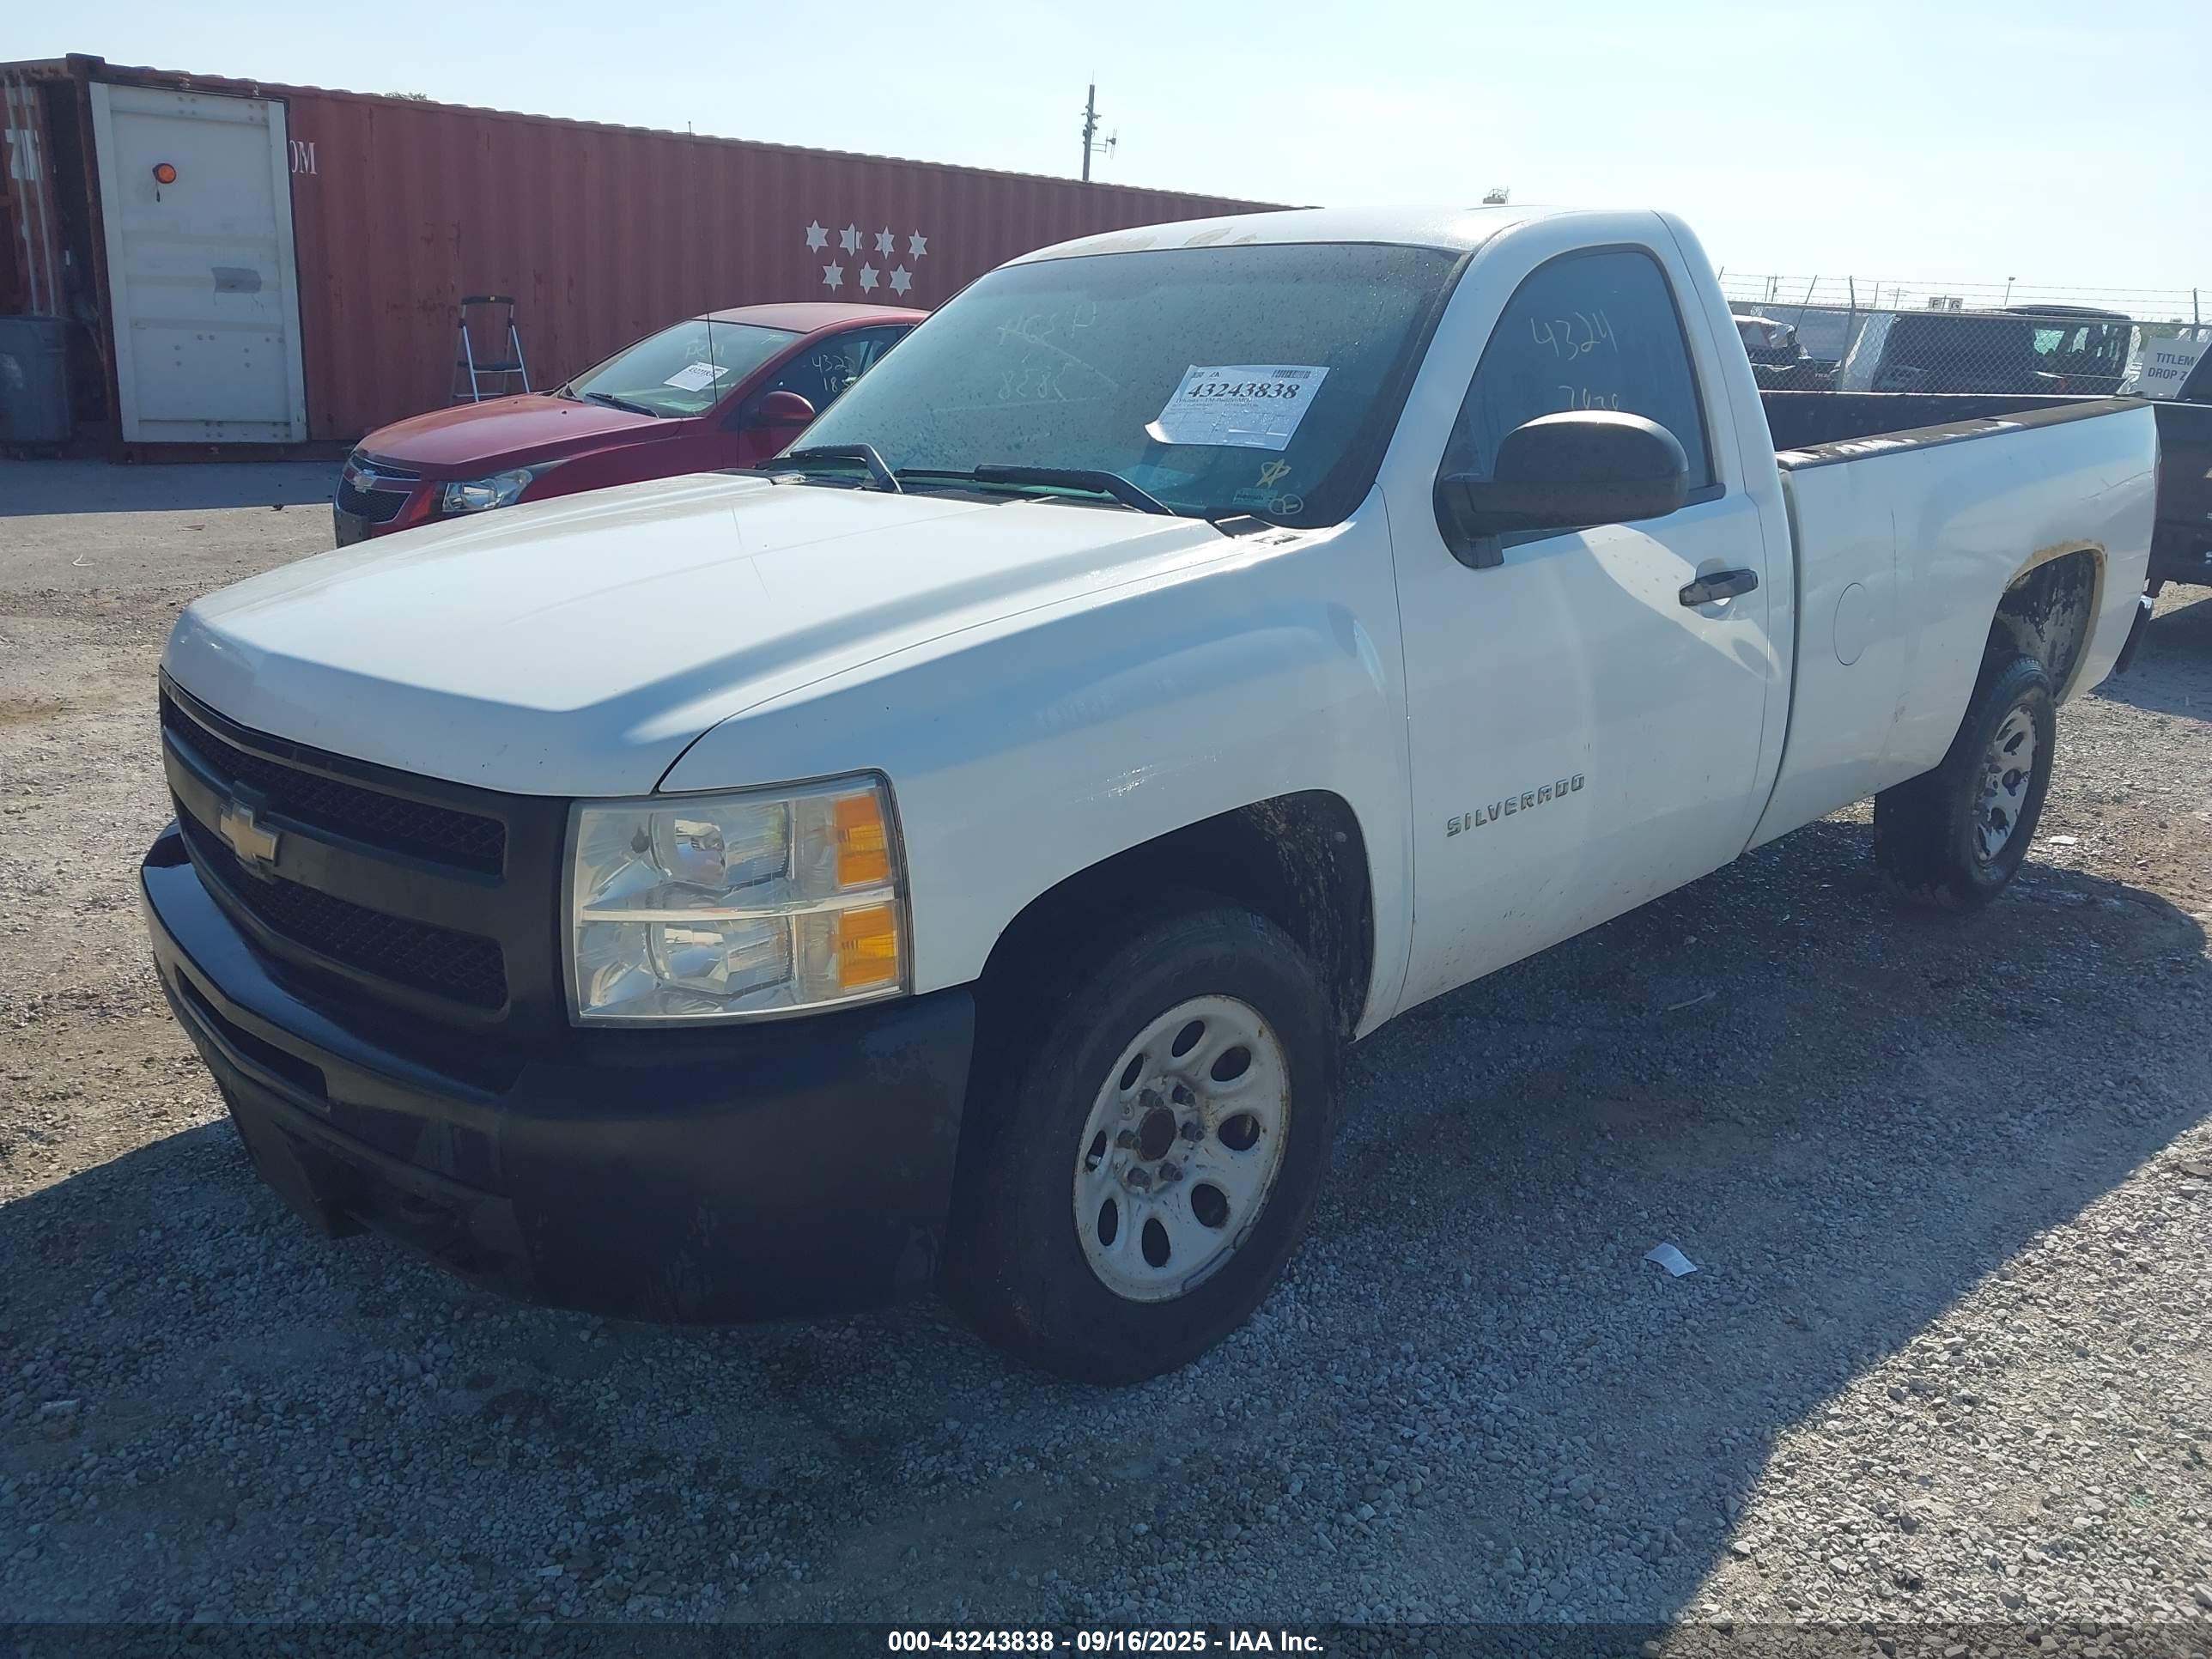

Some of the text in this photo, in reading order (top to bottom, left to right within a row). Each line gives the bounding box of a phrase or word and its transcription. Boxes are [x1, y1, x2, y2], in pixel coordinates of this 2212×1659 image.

[1530, 308, 1618, 361] 4324
[2156, 352, 2194, 366] TITLEM
[2148, 367, 2177, 380] DROP
[1188, 382, 1300, 399] 43243838
[1446, 773, 1585, 837] SILVERADO
